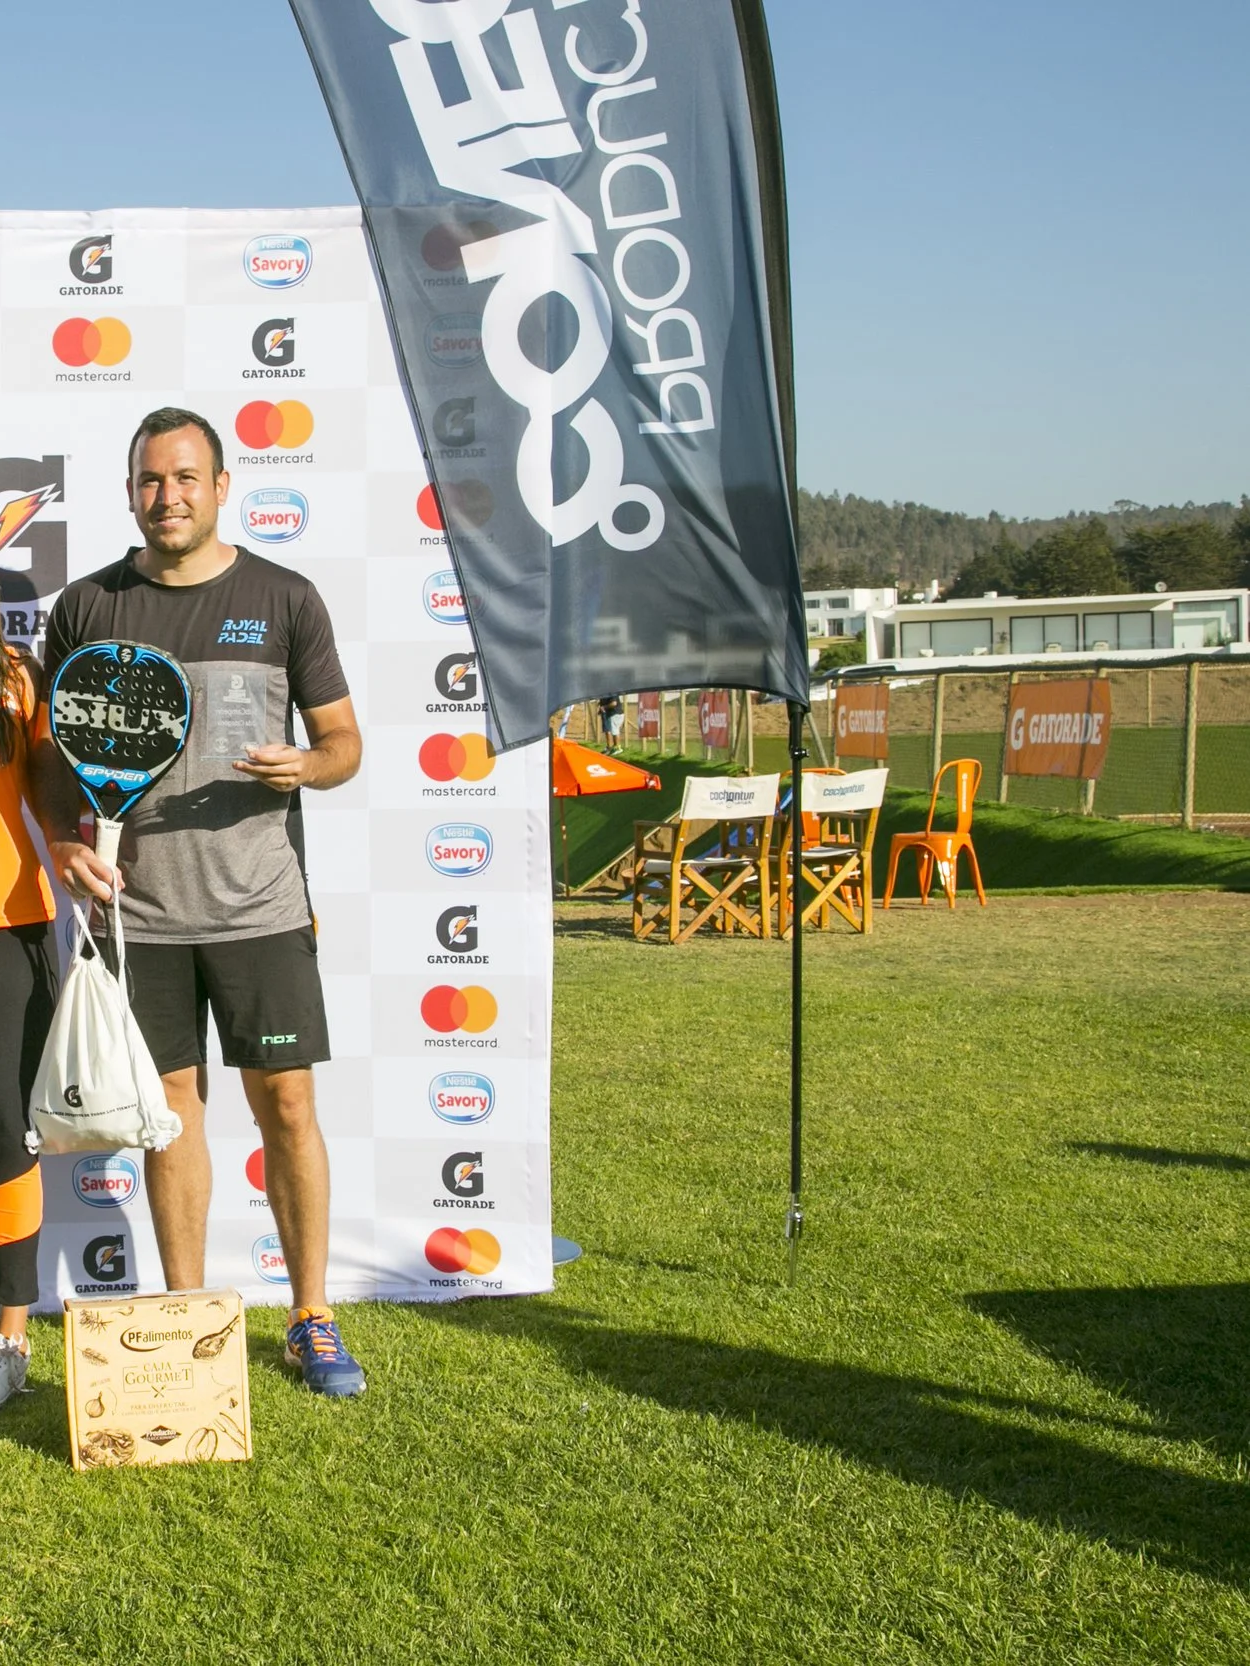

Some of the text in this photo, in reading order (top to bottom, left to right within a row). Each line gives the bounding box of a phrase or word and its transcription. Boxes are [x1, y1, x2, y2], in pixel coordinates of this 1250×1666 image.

[69, 235, 112, 284] G
[252, 257, 303, 272] Savory
[60, 286, 123, 295] GATORADE
[252, 318, 294, 366] G
[56, 371, 130, 381] mastercard
[242, 369, 305, 378] GATORADE
[239, 453, 313, 464] mastercard
[423, 448, 486, 459] TORADE
[249, 512, 300, 527] Savory
[222, 619, 268, 632] ROYAL
[217, 632, 264, 645] PADEL
[435, 651, 478, 701] G
[426, 703, 488, 713] GATORADE
[850, 709, 886, 734] GATORADE
[1029, 713, 1104, 745] GATORADE
[82, 767, 145, 783] SPYDER
[423, 786, 495, 796] mastercard
[434, 846, 484, 861] Savory
[436, 905, 478, 953] G
[428, 956, 489, 964] GATORADE
[425, 1038, 497, 1048] mastercard
[438, 1093, 487, 1111] Savory
[442, 1152, 483, 1197] G
[81, 1176, 132, 1195] Savory
[433, 1199, 494, 1209] GATORADE
[83, 1235, 126, 1282] G
[261, 1254, 286, 1269] Sav
[75, 1284, 137, 1293] GATORADE
[430, 1278, 502, 1290] mastercard
[143, 1361, 172, 1372] CAJA
